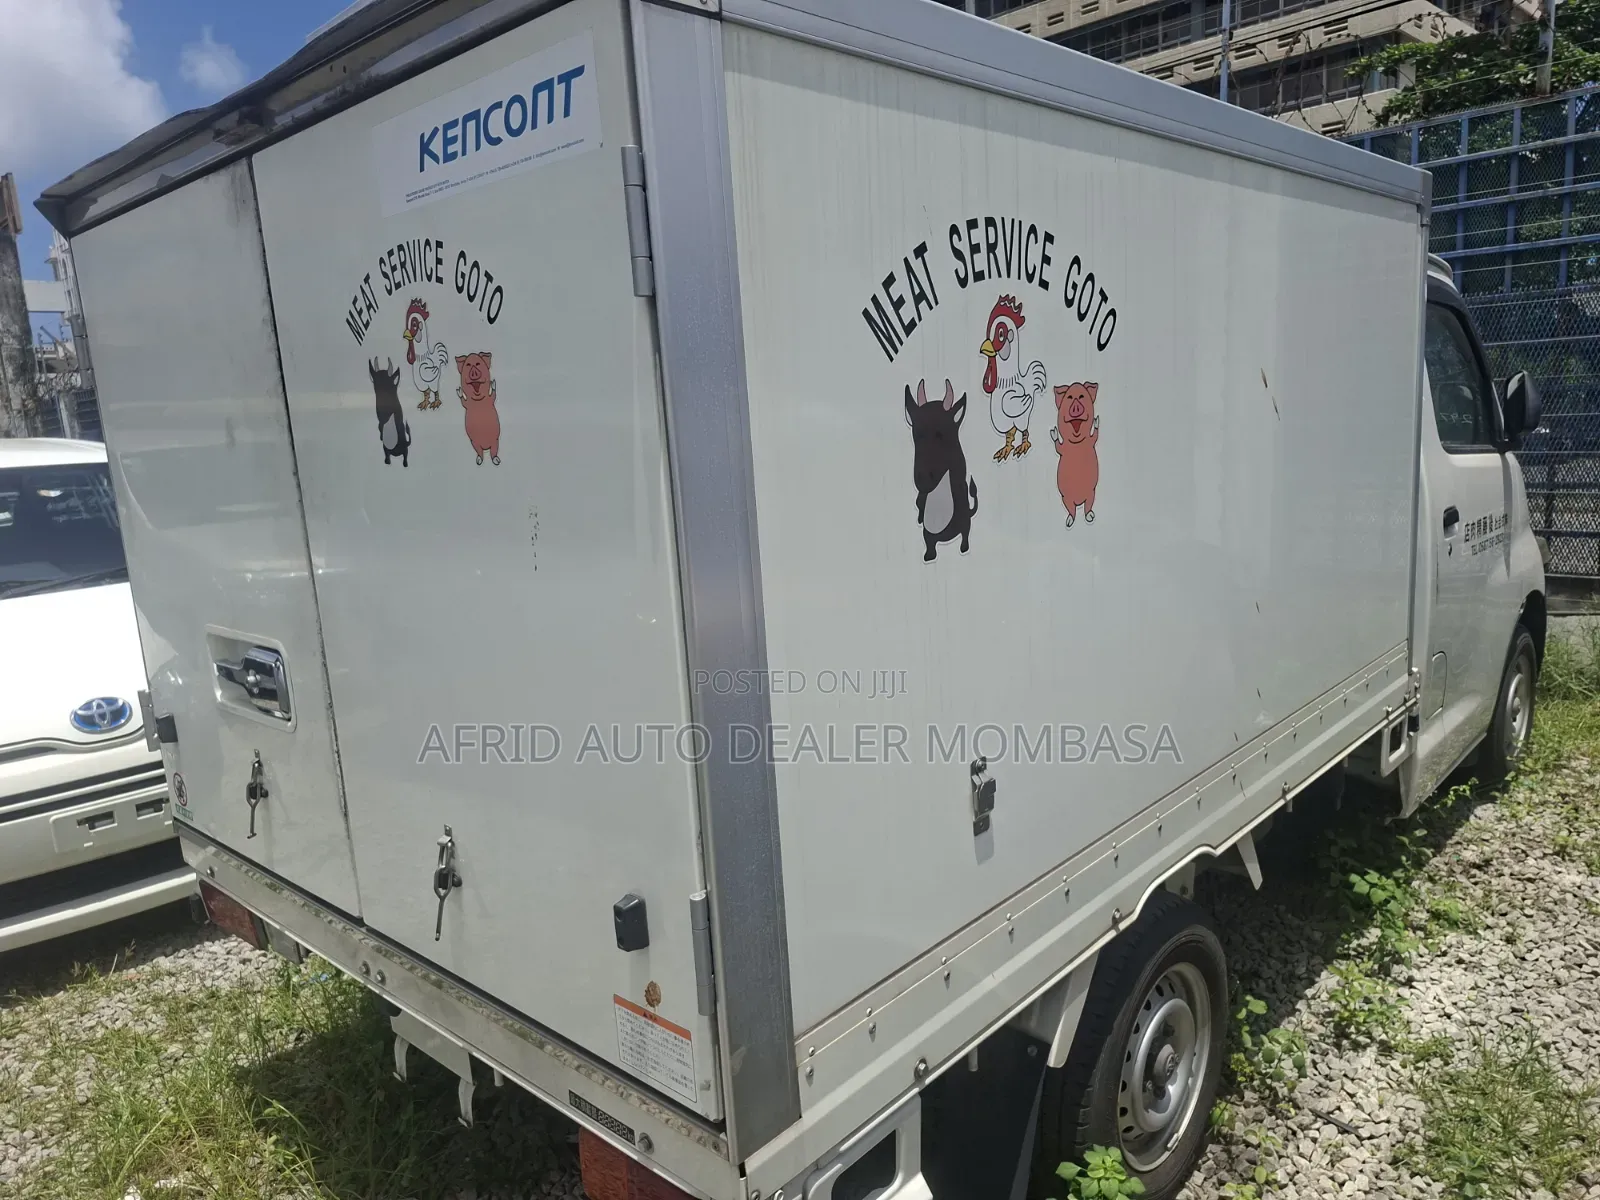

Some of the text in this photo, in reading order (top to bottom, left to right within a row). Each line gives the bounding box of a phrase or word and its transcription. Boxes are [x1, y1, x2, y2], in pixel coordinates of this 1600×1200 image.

[346, 238, 504, 346] MEAT SERVICE GOTO
[861, 216, 1117, 363] MEAT SERVICE GOTO
